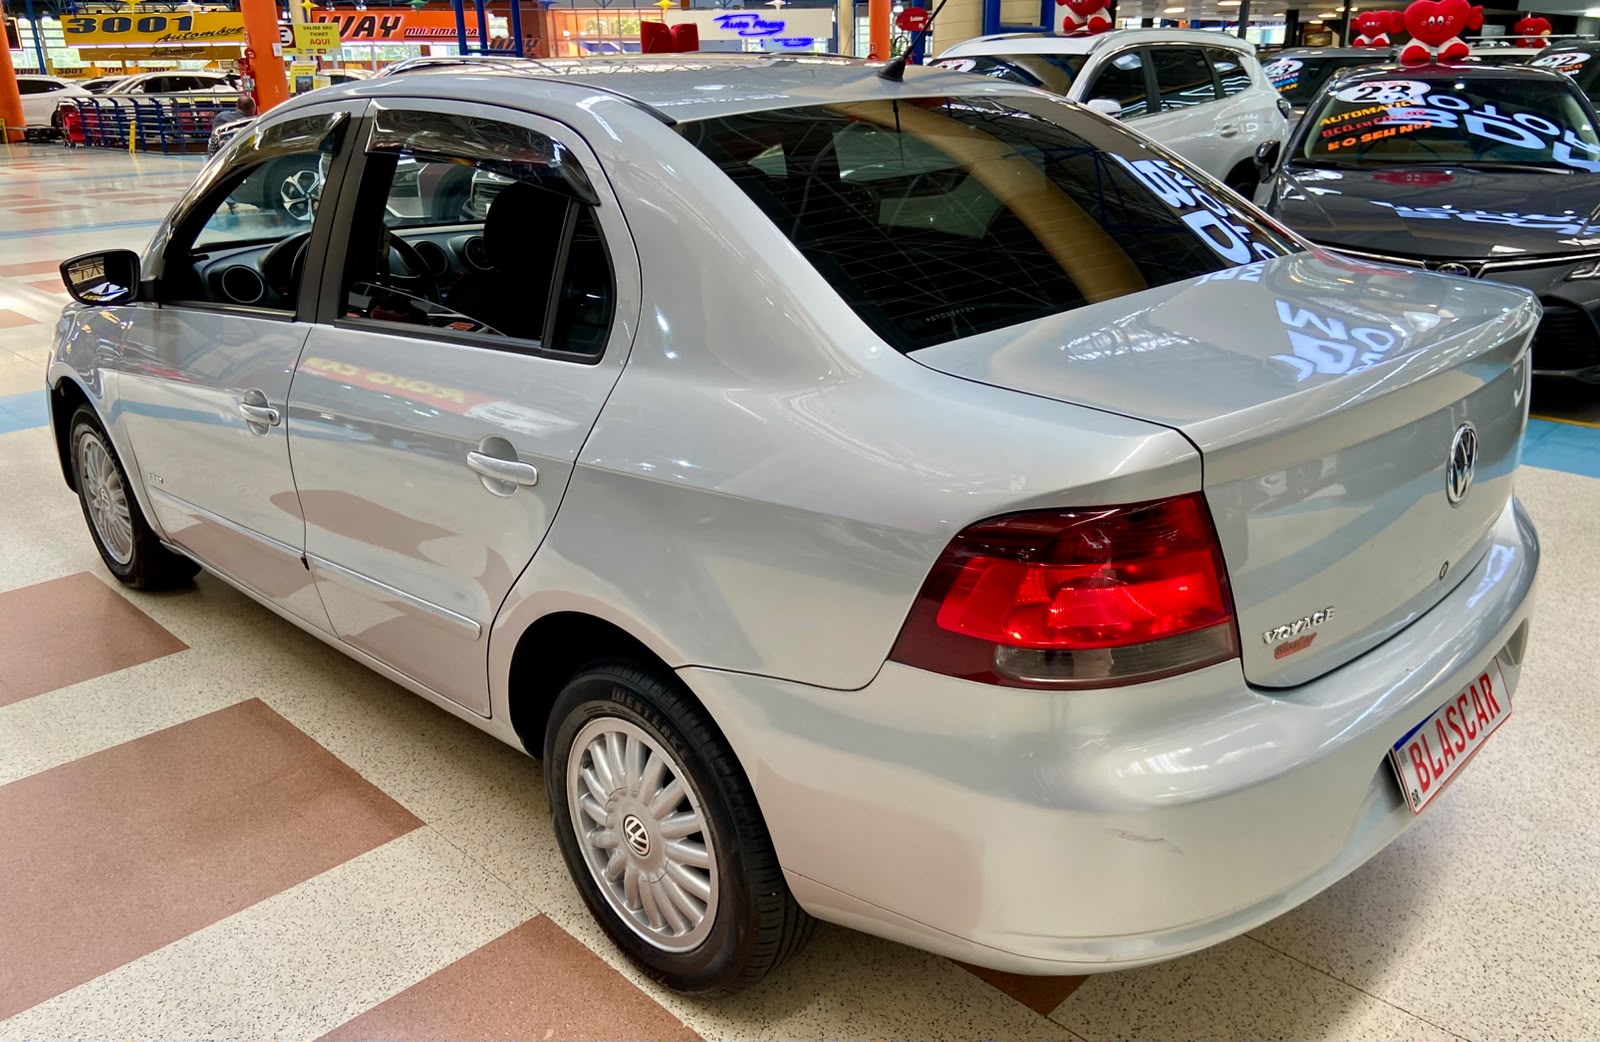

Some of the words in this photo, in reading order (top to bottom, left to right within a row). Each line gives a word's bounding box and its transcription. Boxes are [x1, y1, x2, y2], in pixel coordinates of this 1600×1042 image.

[66, 15, 195, 34] 3001
[1262, 605, 1336, 645] VOYAGE
[1407, 672, 1502, 794] BLASCAR
